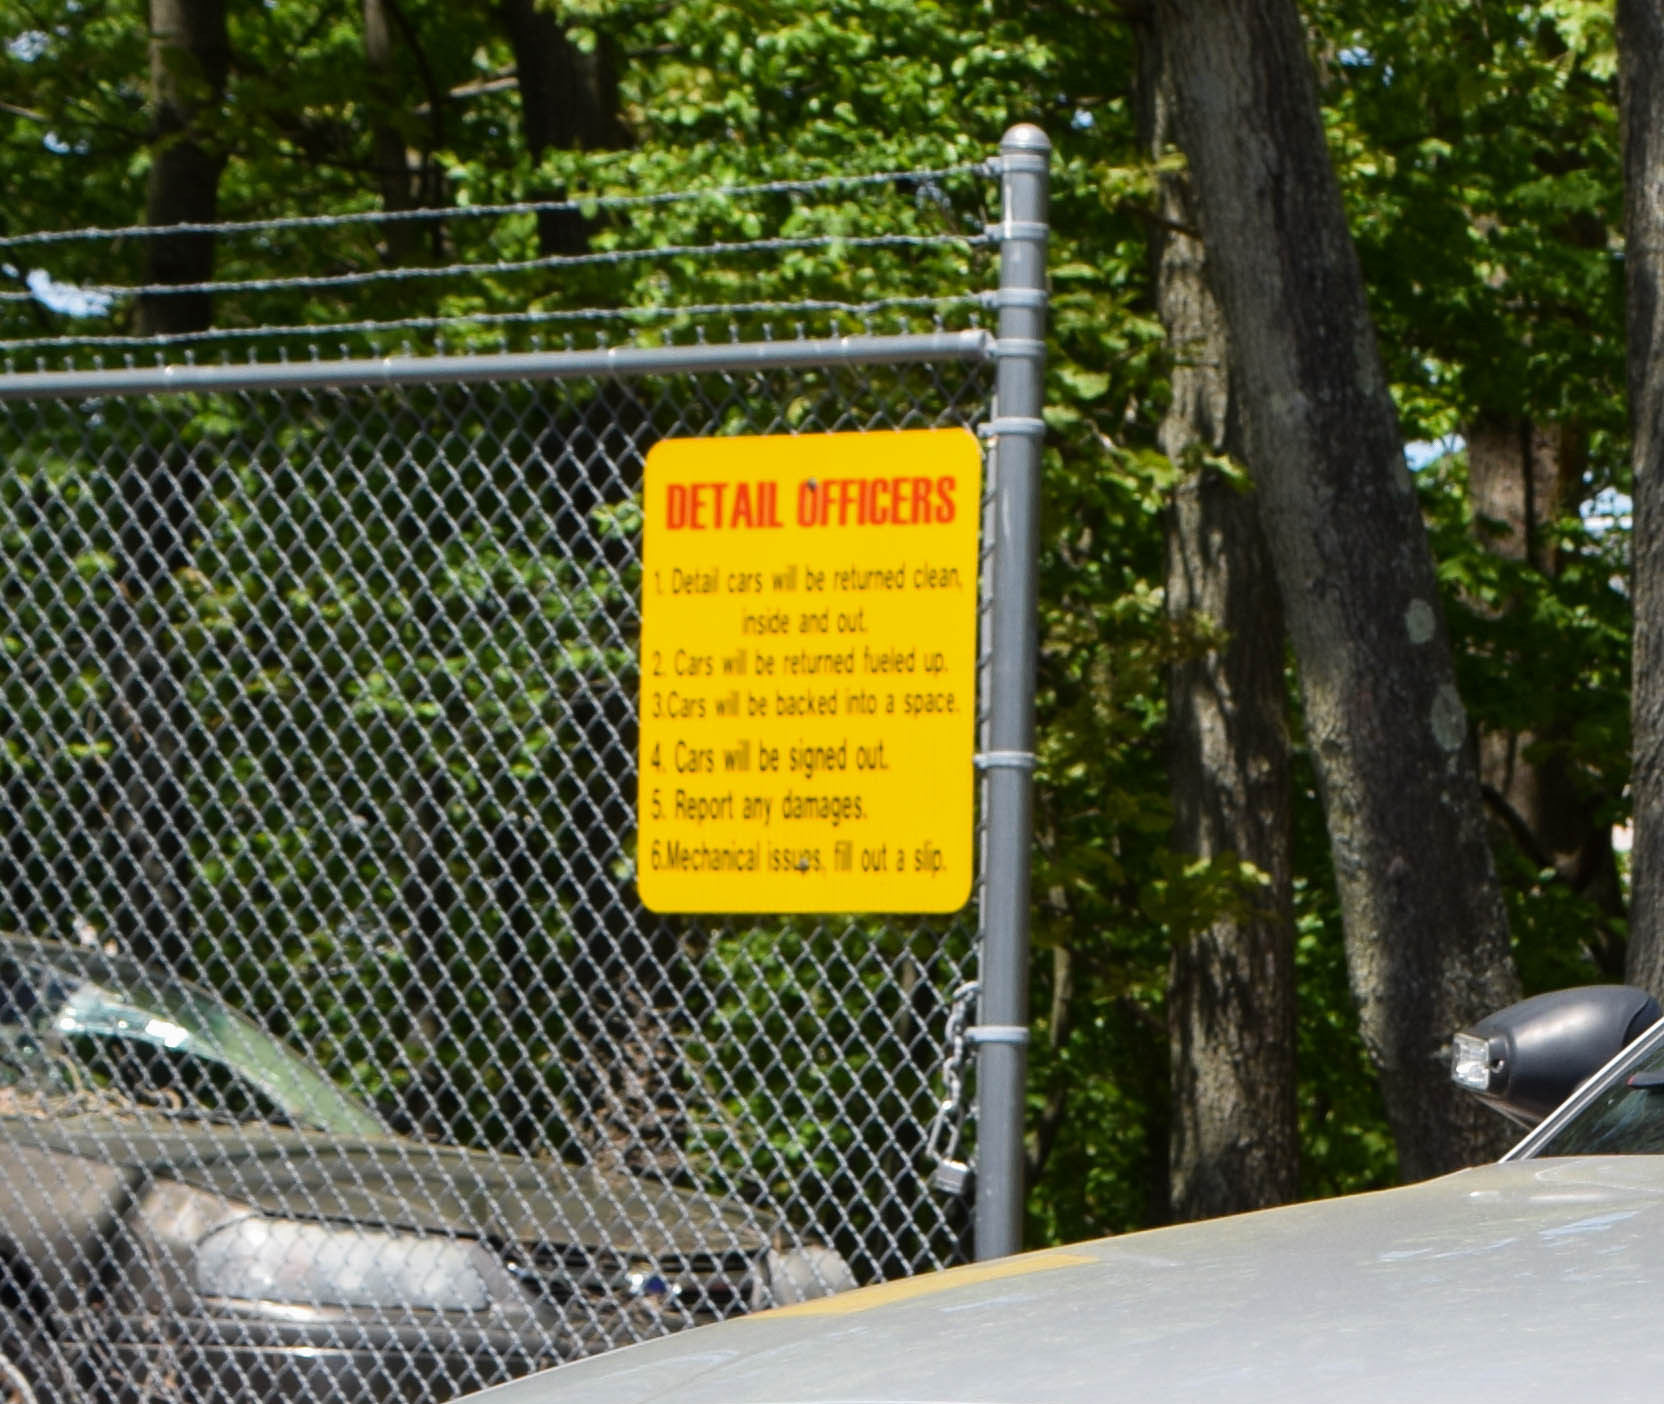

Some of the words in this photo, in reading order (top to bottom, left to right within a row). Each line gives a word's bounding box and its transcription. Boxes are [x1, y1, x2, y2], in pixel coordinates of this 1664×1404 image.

[666, 481, 784, 530] DETAIL
[796, 476, 956, 527] OFFICERS
[672, 566, 720, 595] Detail
[727, 571, 763, 593] cars
[772, 564, 798, 592] will
[804, 564, 825, 592] be
[833, 562, 906, 591] returned
[742, 607, 790, 635] inside
[799, 608, 829, 634] and
[836, 609, 868, 633] out.
[652, 650, 666, 677] 2.
[674, 649, 713, 676] Cars
[723, 649, 748, 675] will
[755, 649, 775, 675] be
[783, 648, 854, 675] returned
[863, 646, 915, 673] fueled
[924, 650, 949, 678] up.
[715, 690, 741, 717] will
[748, 689, 768, 717] be
[776, 689, 837, 716] backed
[845, 688, 877, 715] into
[885, 692, 895, 714] a
[903, 692, 959, 718] space.
[651, 741, 666, 774] 4.
[675, 740, 714, 773] Cars
[724, 739, 750, 772] will
[758, 739, 779, 772] be
[788, 738, 847, 779] signed
[856, 740, 889, 770] out.
[651, 788, 666, 820] 5.
[675, 788, 733, 824] Report
[743, 797, 772, 826] any
[782, 789, 867, 826] damages.
[834, 840, 853, 872] fill
[861, 842, 888, 872] out
[896, 850, 905, 871] a
[913, 841, 947, 876] slip.
